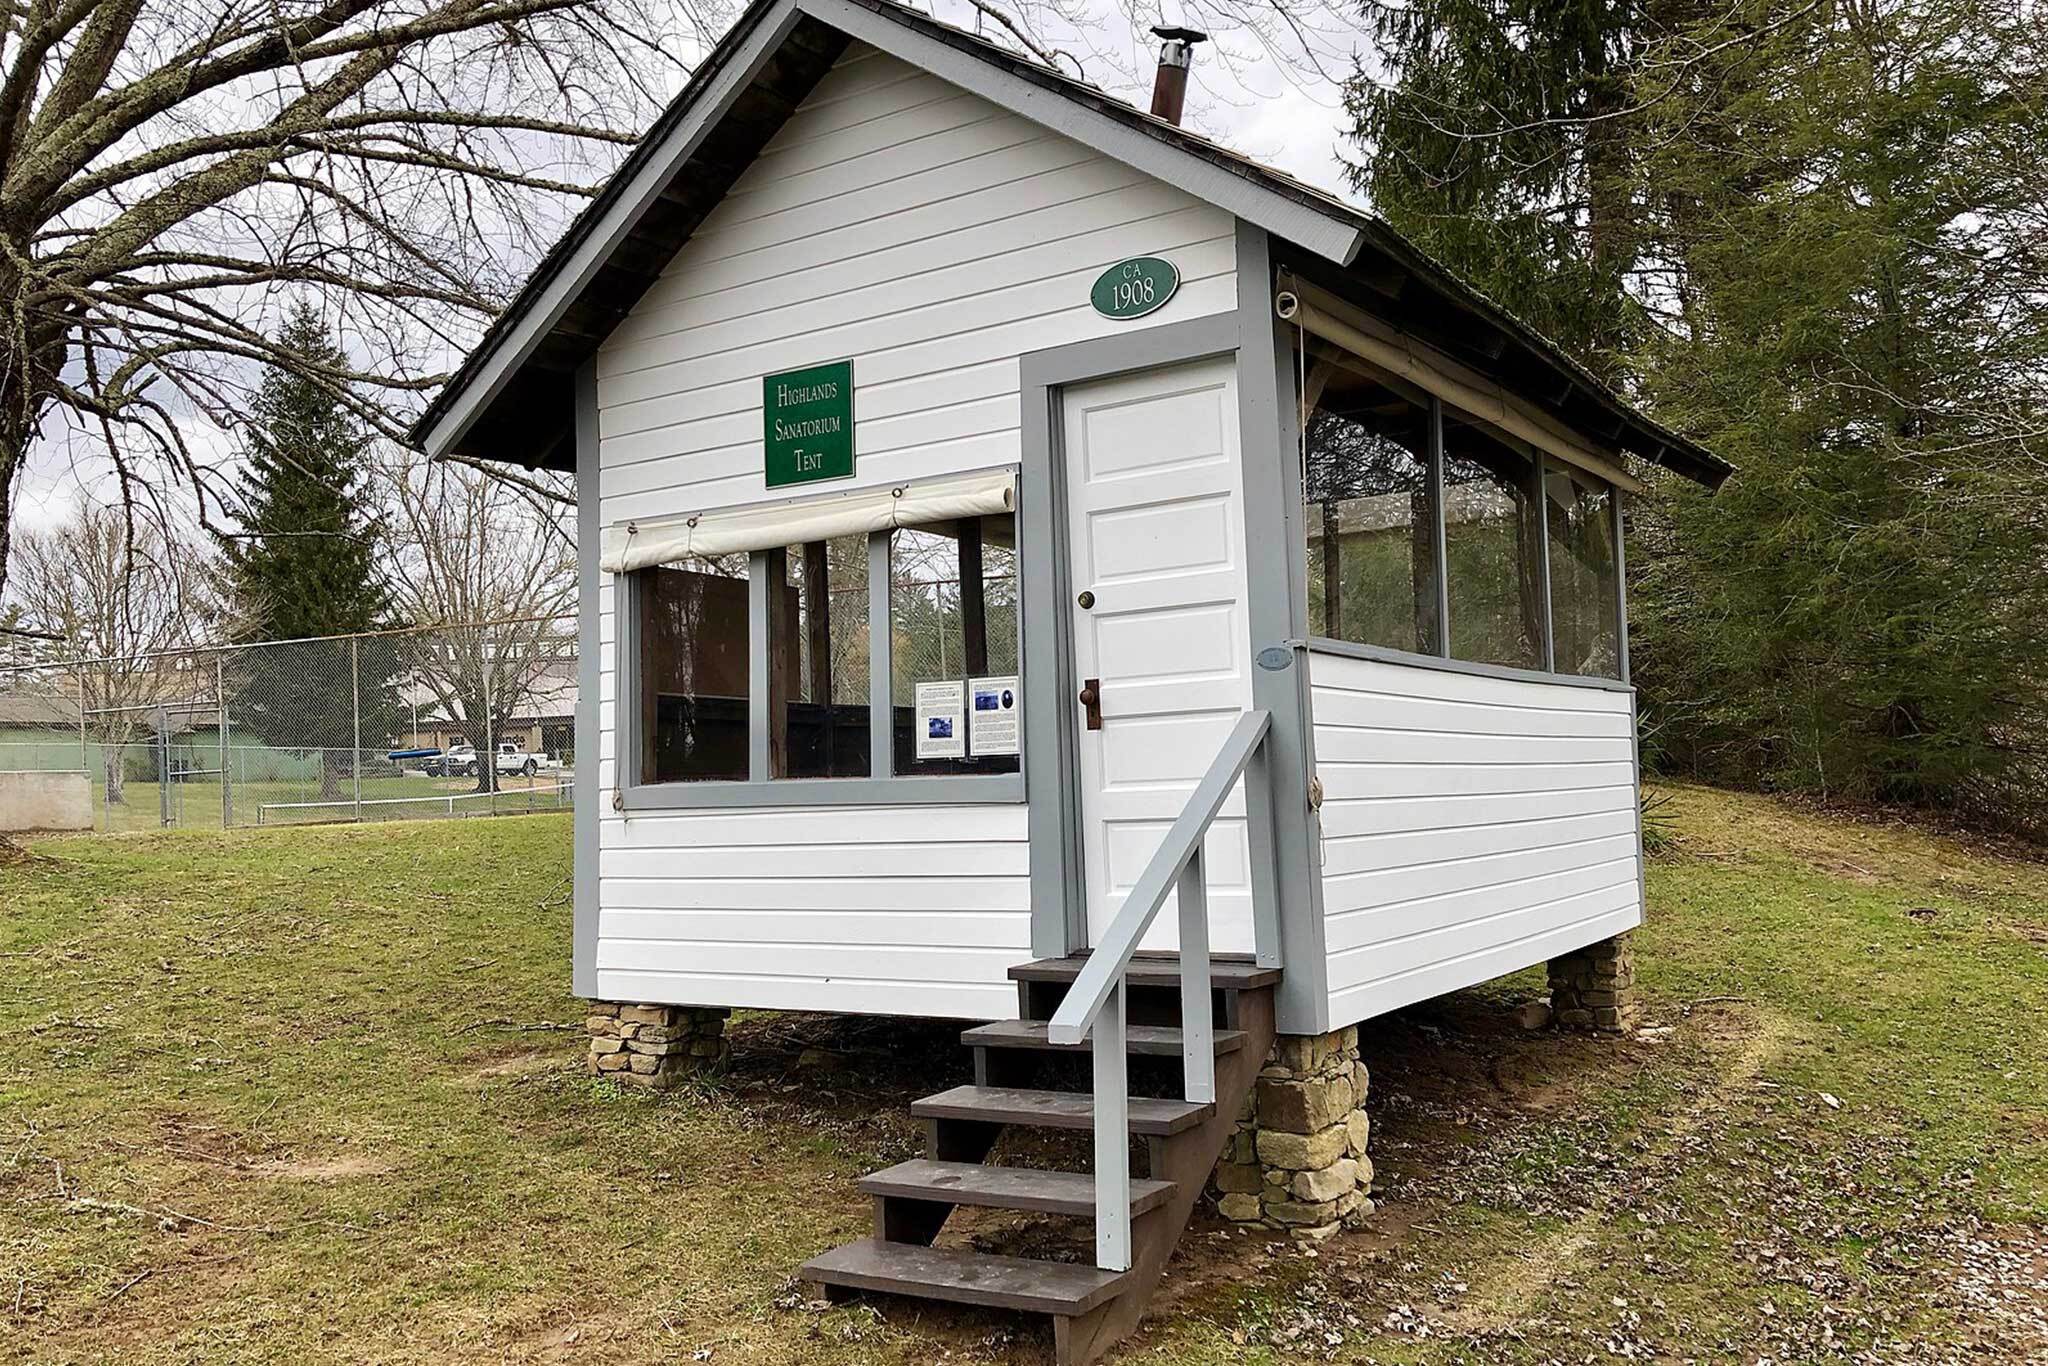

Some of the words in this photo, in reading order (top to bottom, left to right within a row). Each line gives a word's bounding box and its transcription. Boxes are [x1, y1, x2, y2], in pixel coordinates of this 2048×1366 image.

[1123, 263, 1141, 279] CA
[1113, 277, 1154, 310] 1908
[777, 382, 838, 407] HIGHLANDS
[775, 416, 840, 441] SANATORIUM
[793, 449, 823, 472] TENT
